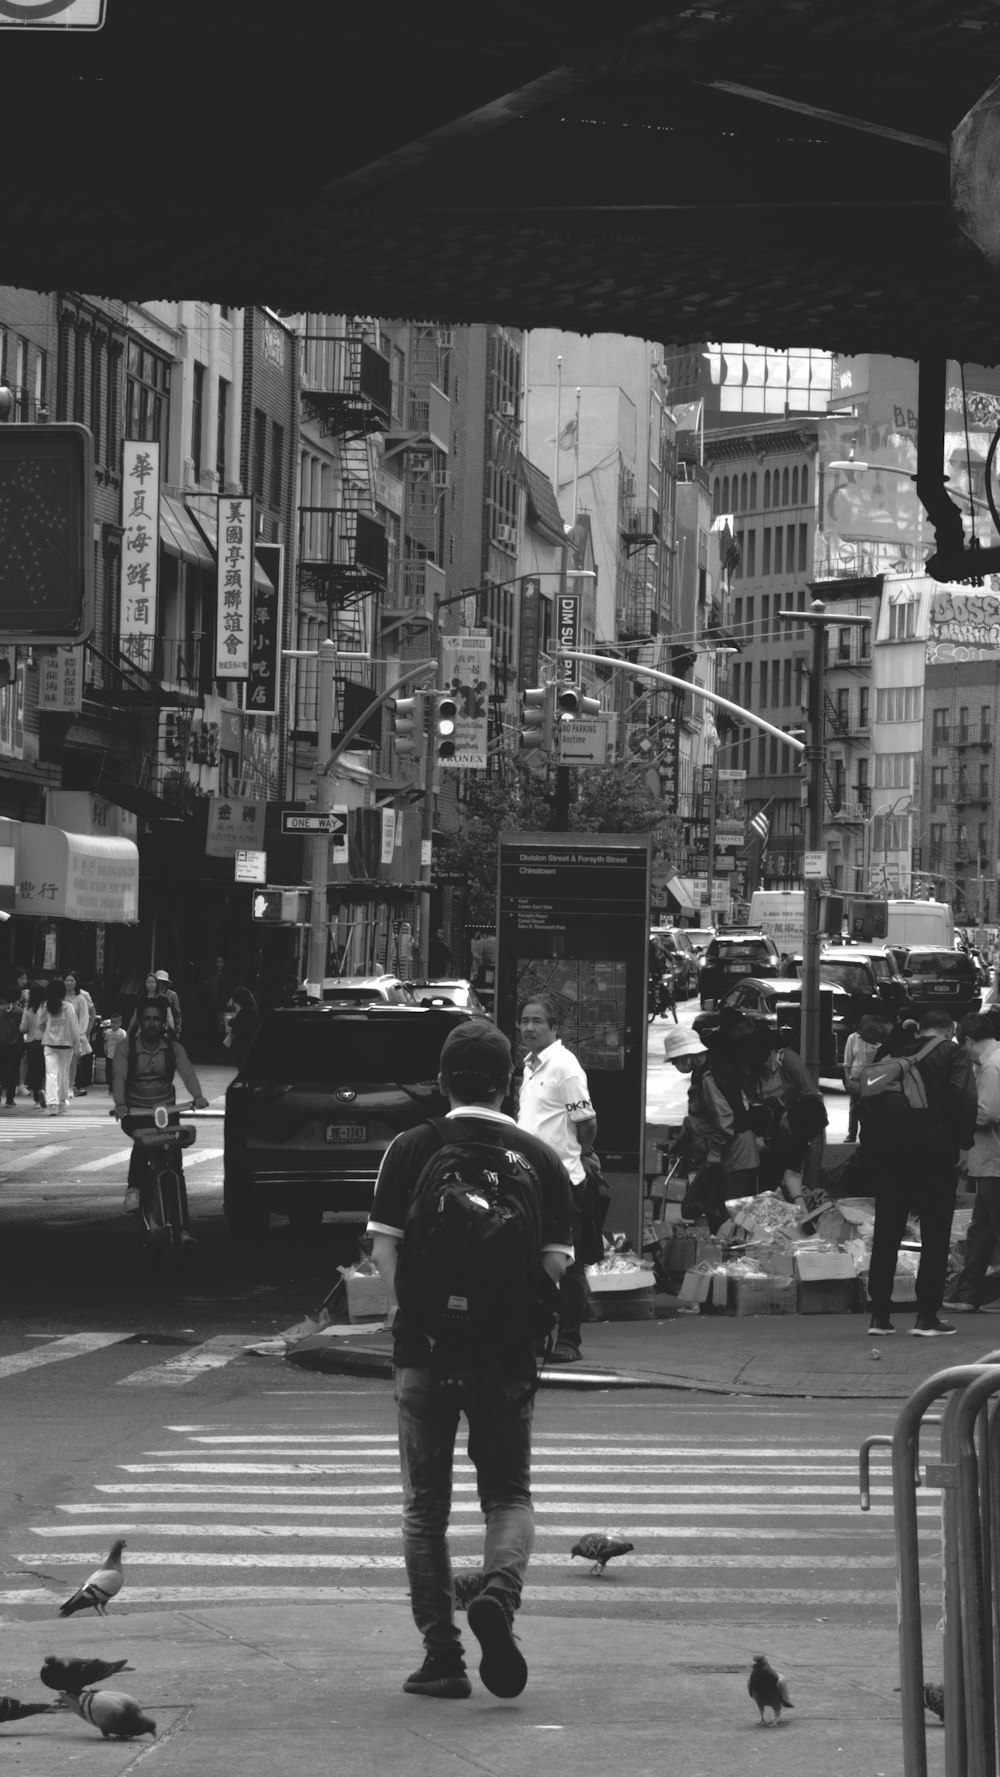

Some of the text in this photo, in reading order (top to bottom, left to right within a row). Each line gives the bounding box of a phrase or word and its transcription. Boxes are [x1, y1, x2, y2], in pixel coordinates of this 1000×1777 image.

[126, 451, 154, 663] 華夏海鮮酒樓
[222, 501, 247, 657] 美國亭頭聯誼會
[561, 599, 575, 625] DIM
[251, 589, 271, 703] 萍小吃店
[562, 725, 597, 734] NO PARKING
[562, 735, 586, 745] Anytime
[291, 818, 338, 828] ONE WAY
[519, 854, 628, 866] Division Street & Forsyth Street
[519, 867, 556, 875] Chinatown
